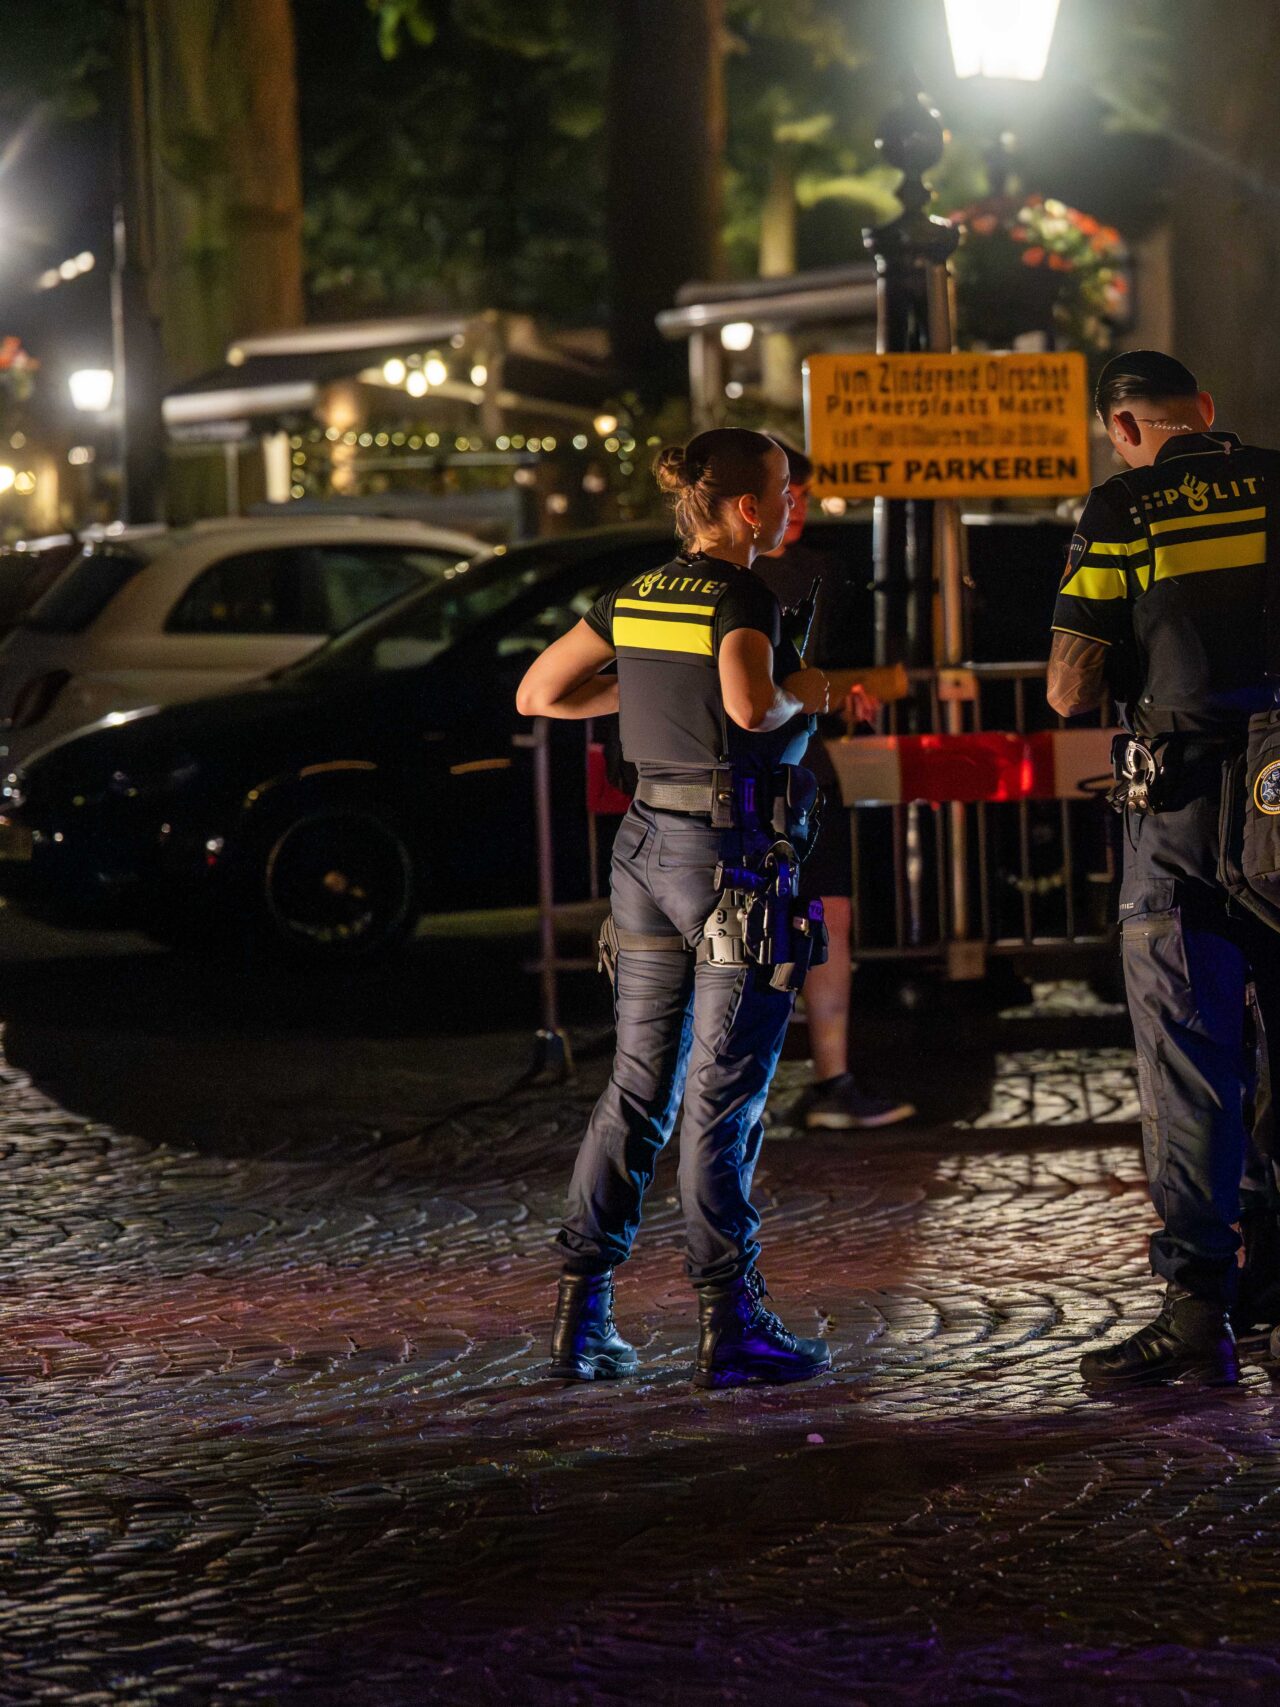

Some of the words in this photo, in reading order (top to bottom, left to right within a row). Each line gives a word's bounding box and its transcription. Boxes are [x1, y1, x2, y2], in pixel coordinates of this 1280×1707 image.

[817, 460, 894, 485] NIET
[904, 456, 1078, 482] PARKEREN
[1164, 478, 1264, 511] POLIT
